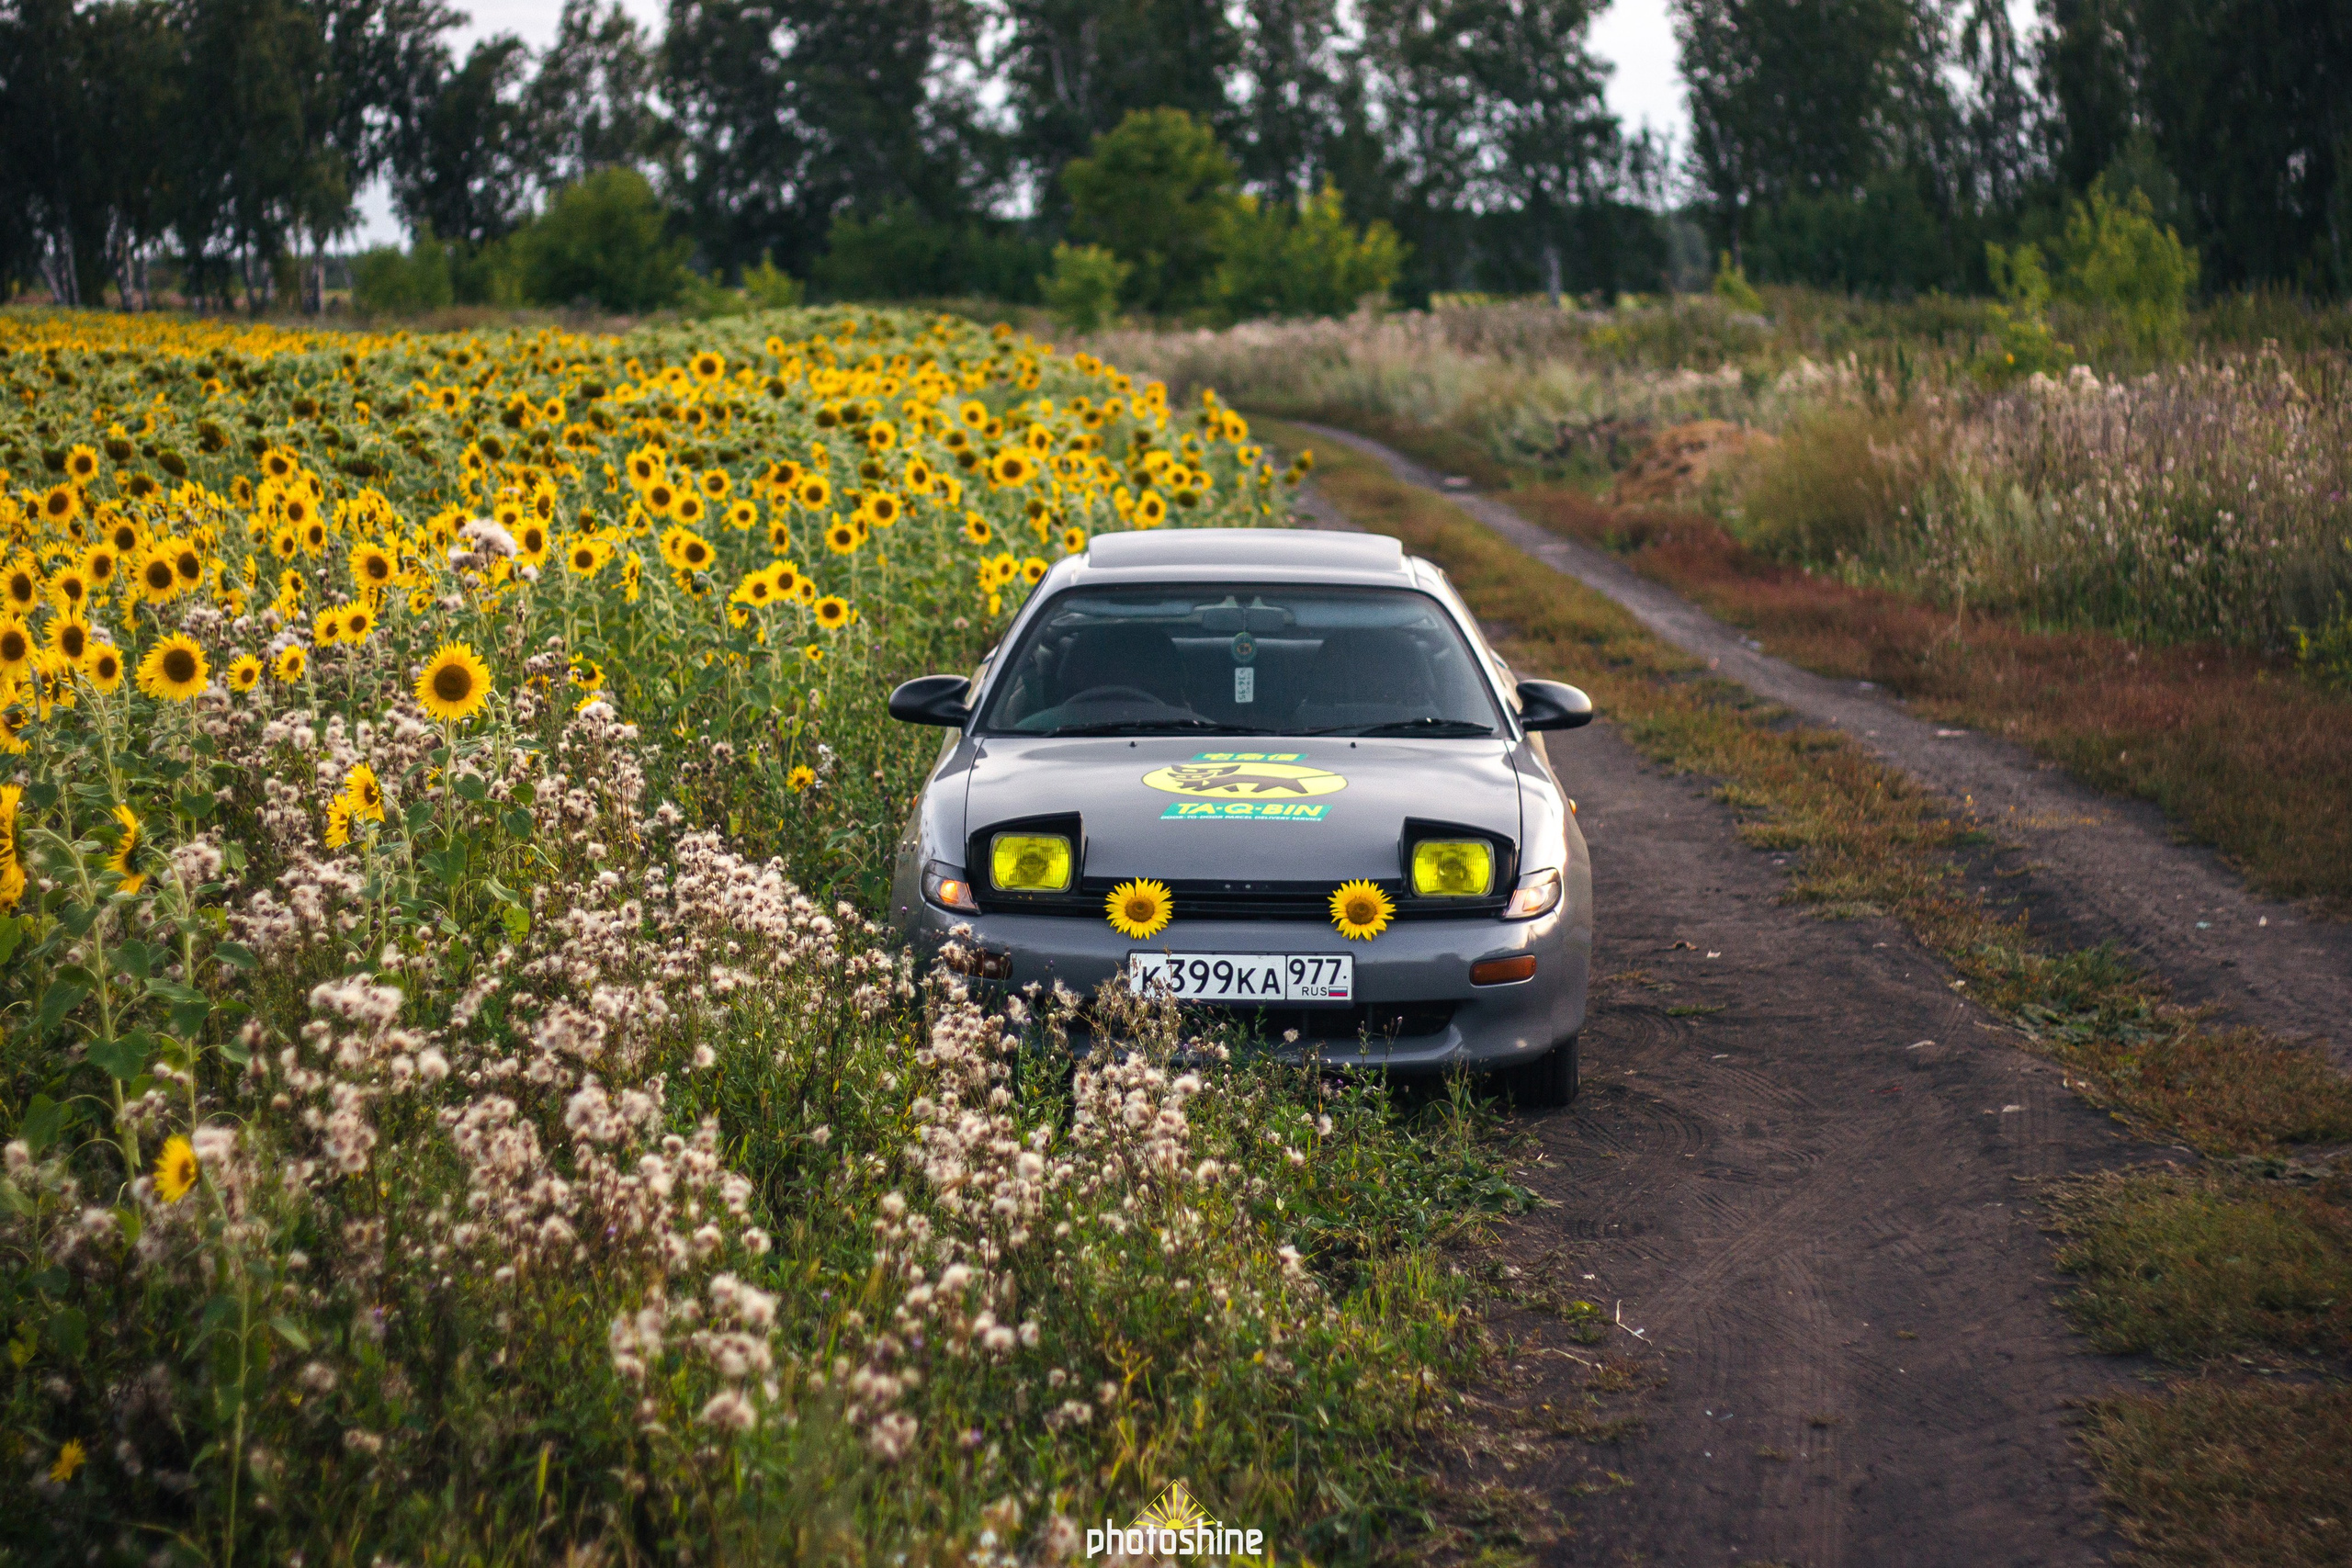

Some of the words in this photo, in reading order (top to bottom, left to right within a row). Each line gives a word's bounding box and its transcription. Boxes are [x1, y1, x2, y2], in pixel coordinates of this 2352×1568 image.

[1177, 803, 1323, 816] TA-Q-BIN
[1289, 958, 1342, 986] 977
[1301, 987, 1328, 997] RUS
